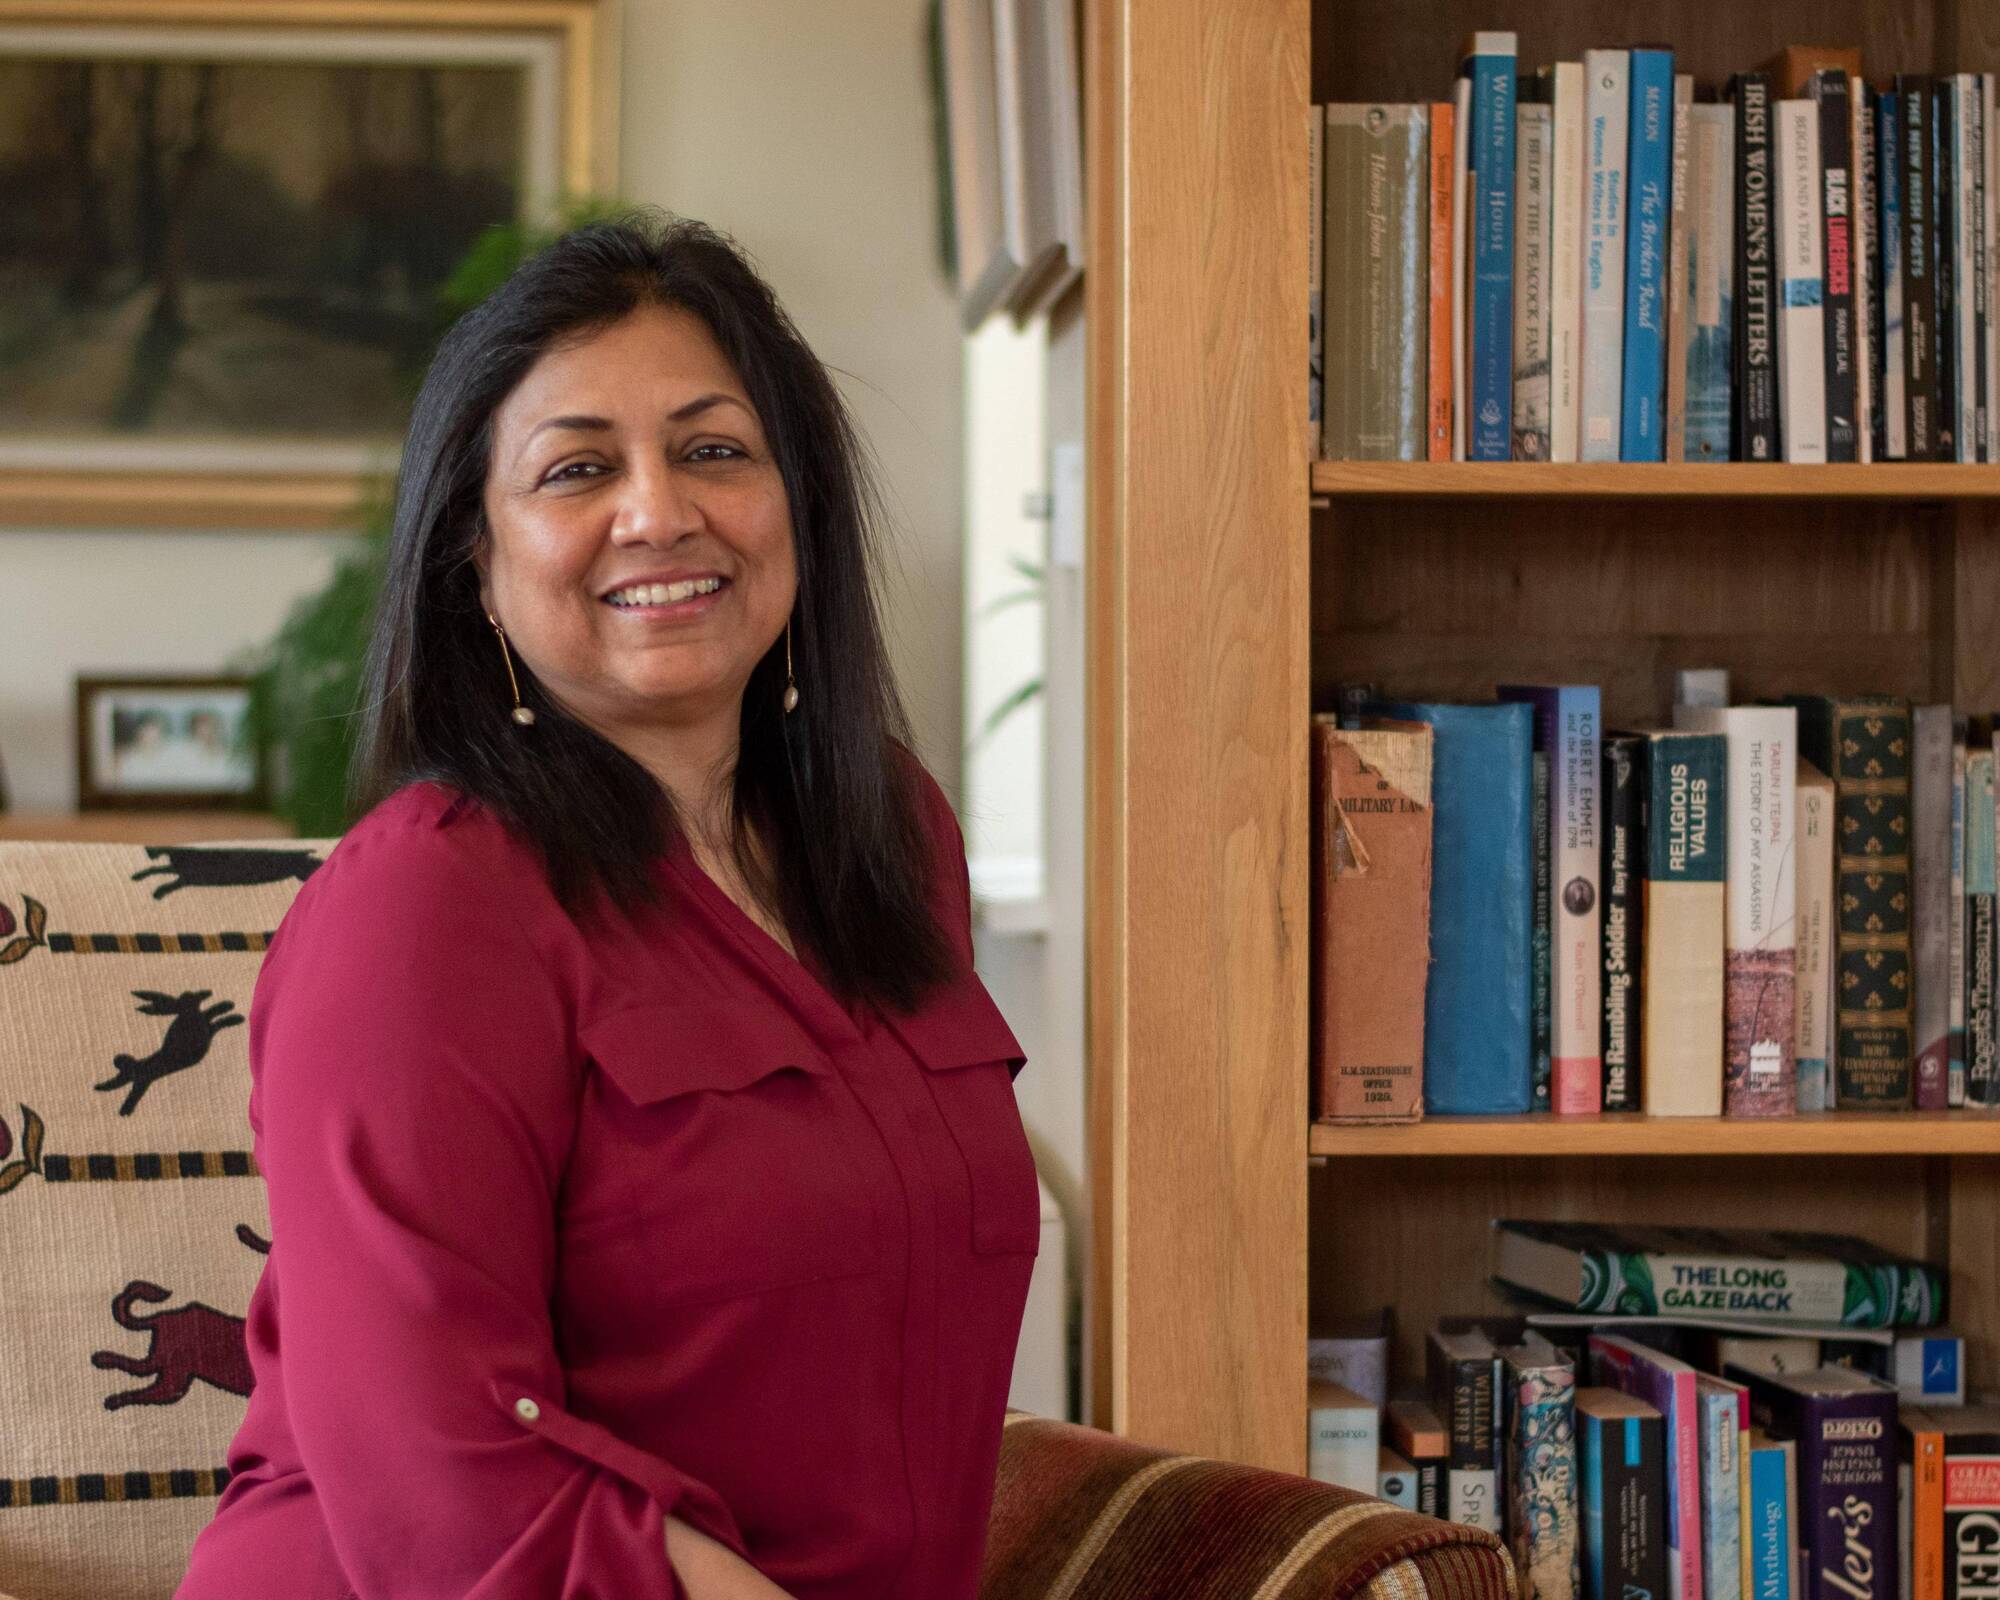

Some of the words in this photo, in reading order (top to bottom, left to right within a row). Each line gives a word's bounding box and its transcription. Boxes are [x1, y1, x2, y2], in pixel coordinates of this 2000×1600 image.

[1602, 73, 1615, 89] 6
[1492, 74, 1509, 147] WOMEN
[1745, 83, 1766, 143] IRISH
[1908, 91, 1922, 125] THE
[1593, 115, 1606, 166] Women
[1908, 130, 1923, 170] NEW
[1528, 138, 1542, 193] BELOW
[1592, 171, 1605, 219] Writers
[1608, 169, 1621, 221] Studies
[1641, 181, 1661, 215] The
[1745, 149, 1768, 260] WOMEN'S
[1825, 169, 1847, 215] BLACK
[1908, 172, 1923, 221] IRISH
[1490, 190, 1506, 252] HOUSE
[1527, 201, 1541, 236] THE
[1592, 223, 1605, 236] in
[1608, 224, 1619, 237] in
[1589, 241, 1603, 290] English
[1640, 220, 1660, 278] Broken
[1827, 217, 1849, 296] LIMERICKS
[1909, 223, 1925, 279] POETS
[1526, 243, 1540, 319] PEACOCK
[1638, 283, 1659, 333] Road
[1746, 265, 1769, 366] LETTERS
[1526, 326, 1539, 358] FAN
[1567, 711, 1577, 732] and
[1567, 736, 1577, 753] the
[1579, 713, 1592, 778] ROBERT
[1750, 741, 1762, 767] THE
[1769, 740, 1781, 788] TARUN
[1338, 798, 1396, 812] MILITARY
[1567, 758, 1577, 806] Rebellion
[1750, 772, 1762, 814] STORY
[1567, 811, 1577, 822] of
[1567, 827, 1577, 848] 1798
[1579, 787, 1593, 849] EMMET
[1669, 763, 1688, 871] RELIGIOUS
[1689, 778, 1708, 857] VALUES
[1750, 817, 1762, 834] OF
[1612, 825, 1626, 868] Palmer
[1750, 838, 1762, 859] MY
[1612, 871, 1627, 895] Roy
[1749, 862, 1762, 932] ASSASSINS
[1604, 903, 1626, 971] Soldier
[1970, 894, 1993, 1008] Thesaurus
[1605, 973, 1632, 1064] Rambling
[1970, 1009, 1995, 1081] Roget's
[1605, 1067, 1625, 1104] The
[1662, 1288, 1726, 1309] GAZE
[1728, 1292, 1793, 1312] BACK
[1673, 1265, 1717, 1287] THE
[1719, 1267, 1787, 1289] LONG
[1455, 1385, 1471, 1444] SAFIRE
[1474, 1374, 1489, 1451] WILLIAM
[1823, 1421, 1883, 1439] Oxford
[1759, 1498, 1784, 1598] Mythology
